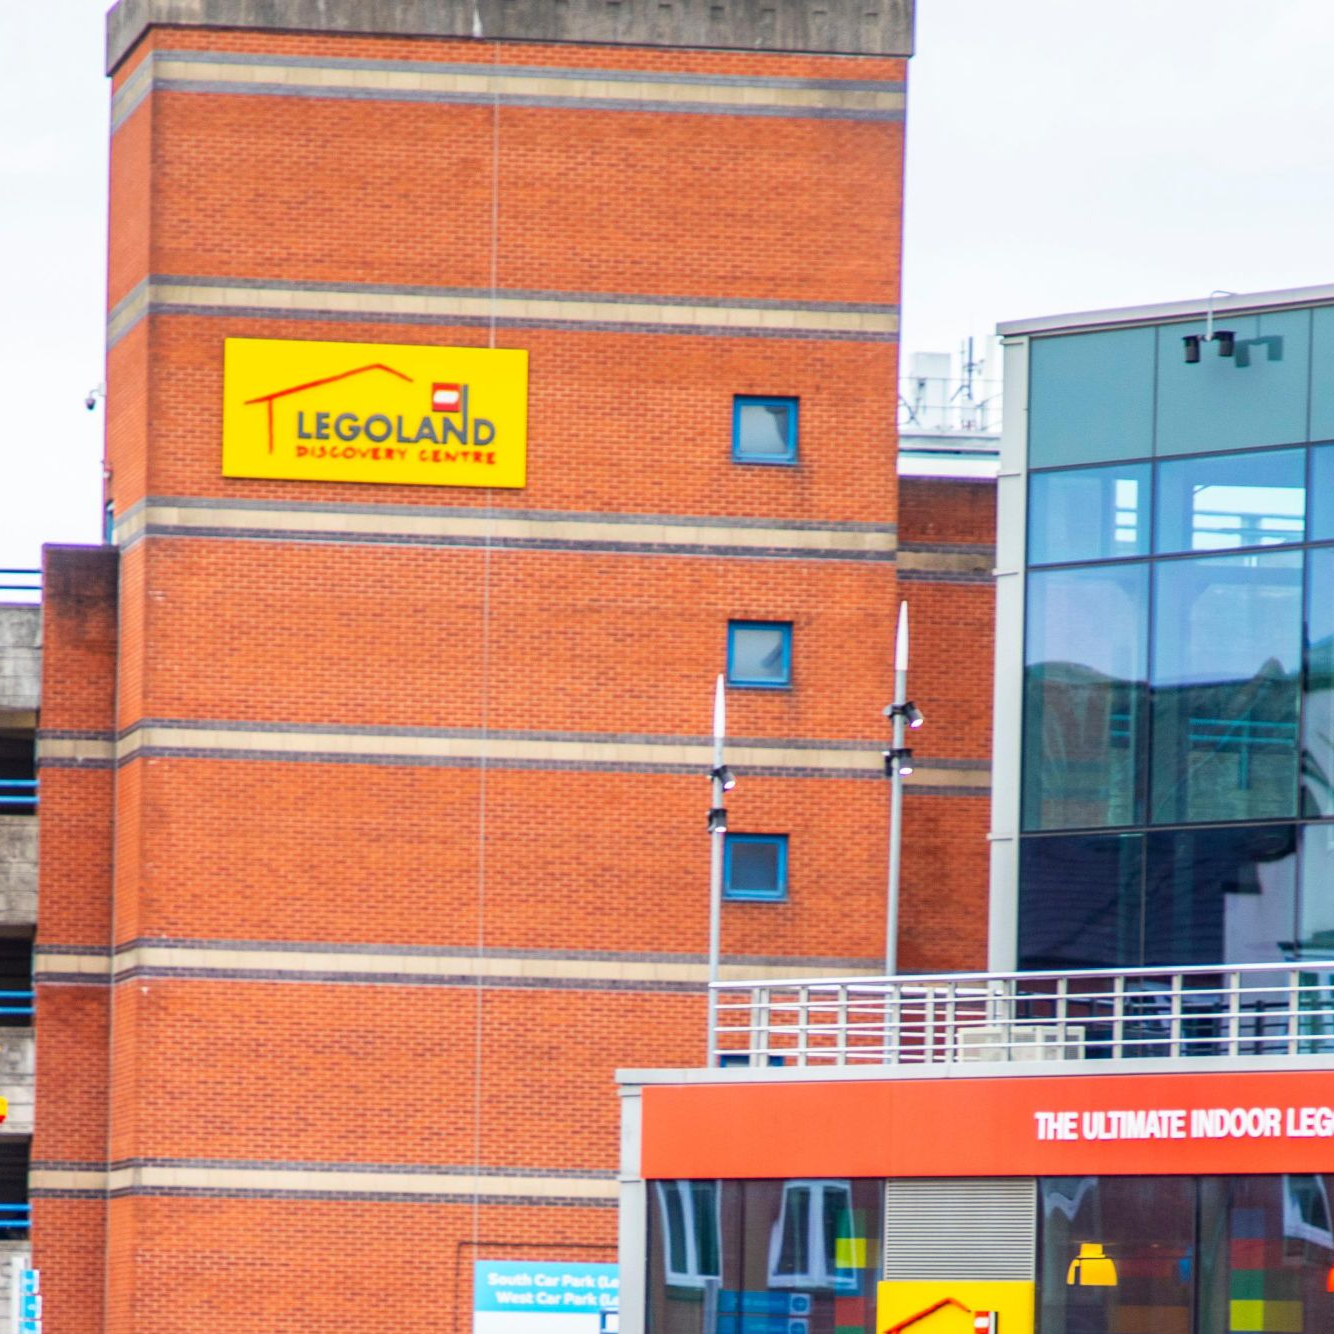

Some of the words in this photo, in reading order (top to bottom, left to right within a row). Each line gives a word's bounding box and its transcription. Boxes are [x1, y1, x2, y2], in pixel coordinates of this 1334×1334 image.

[297, 394, 496, 446] LEGOLAND
[296, 446, 408, 461] DISCOVERY
[418, 449, 496, 465] CENTRE
[1034, 1111, 1079, 1140] THE
[1082, 1109, 1187, 1140] ULTIMATE
[1191, 1107, 1282, 1138] INDOOR
[487, 1272, 533, 1287] South
[534, 1274, 560, 1287] Car
[562, 1274, 596, 1288] Park
[536, 1291, 561, 1305] Car
[564, 1292, 597, 1306] Park
